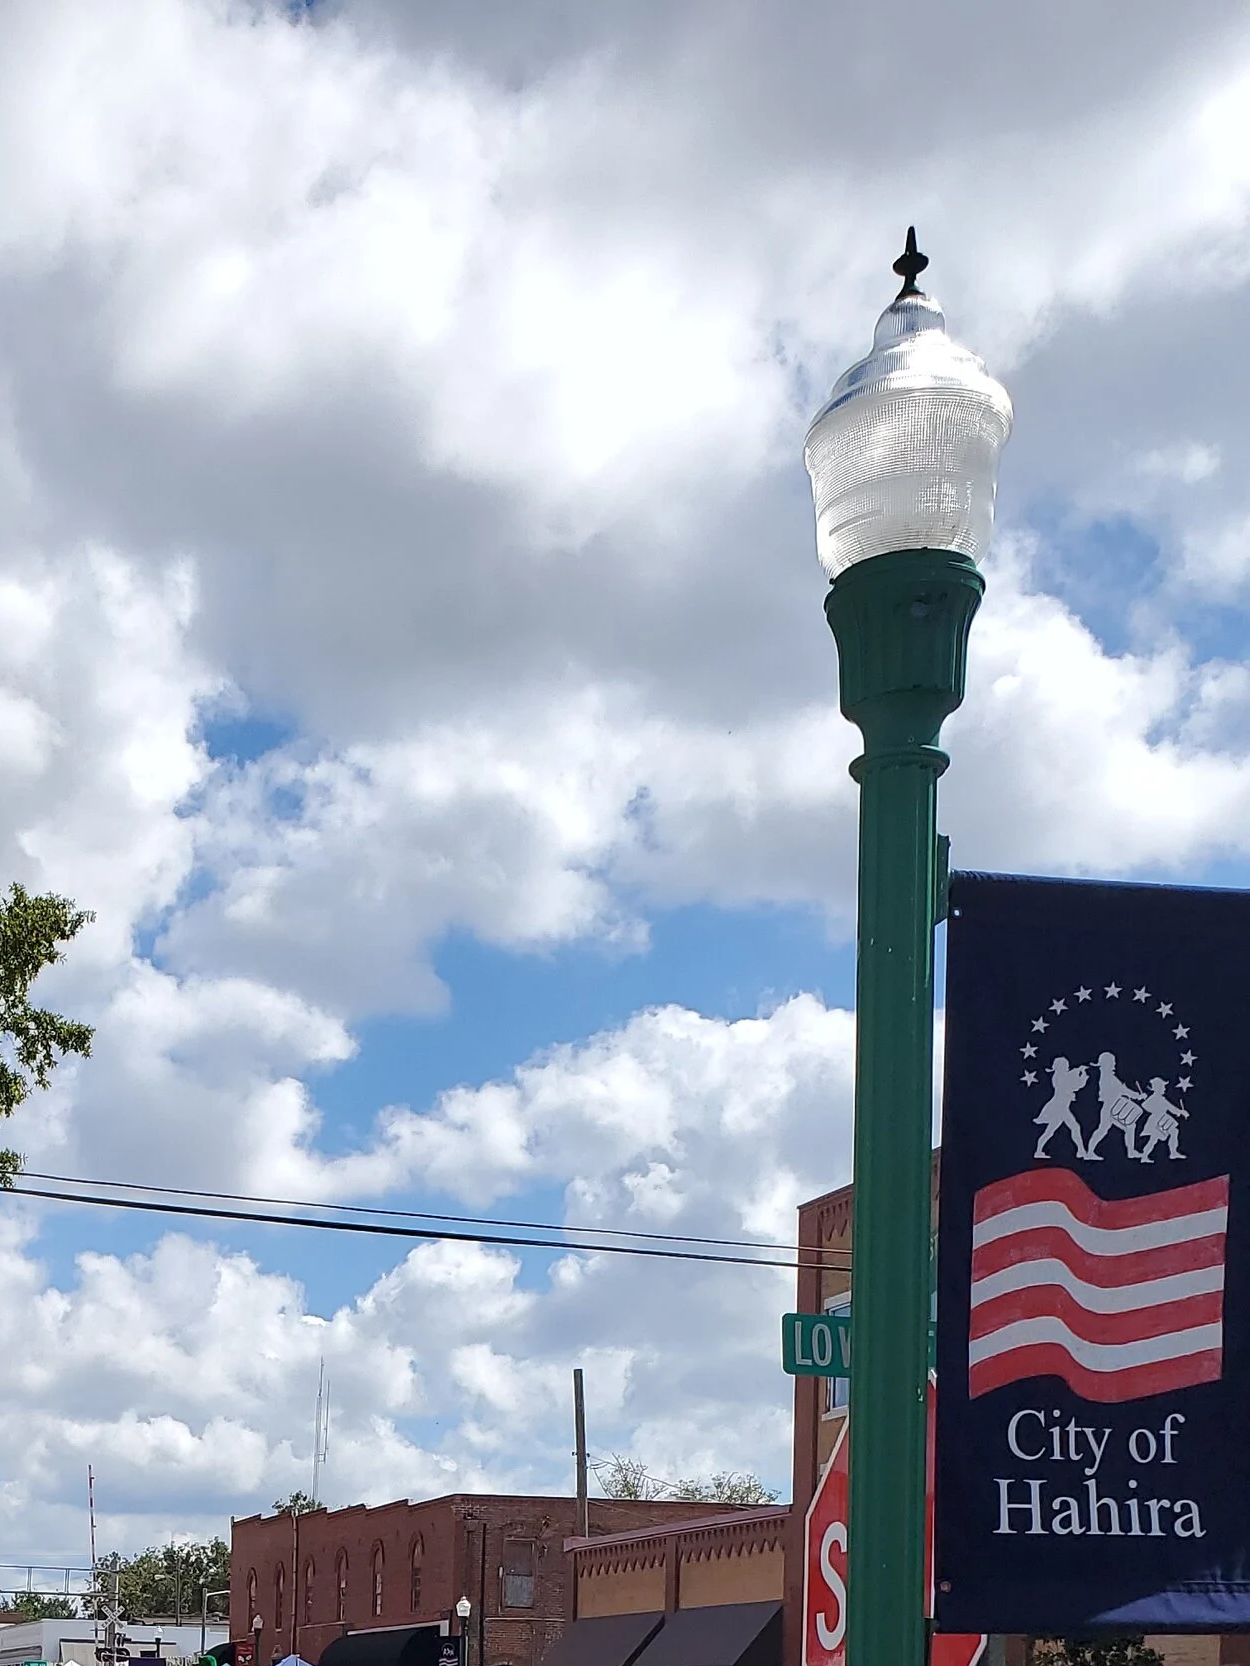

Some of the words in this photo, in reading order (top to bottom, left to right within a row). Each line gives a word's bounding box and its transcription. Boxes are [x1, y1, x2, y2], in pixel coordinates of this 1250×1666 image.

[1007, 1409, 1111, 1475] City
[1129, 1413, 1185, 1465] of
[993, 1478, 1207, 1539] Hahira
